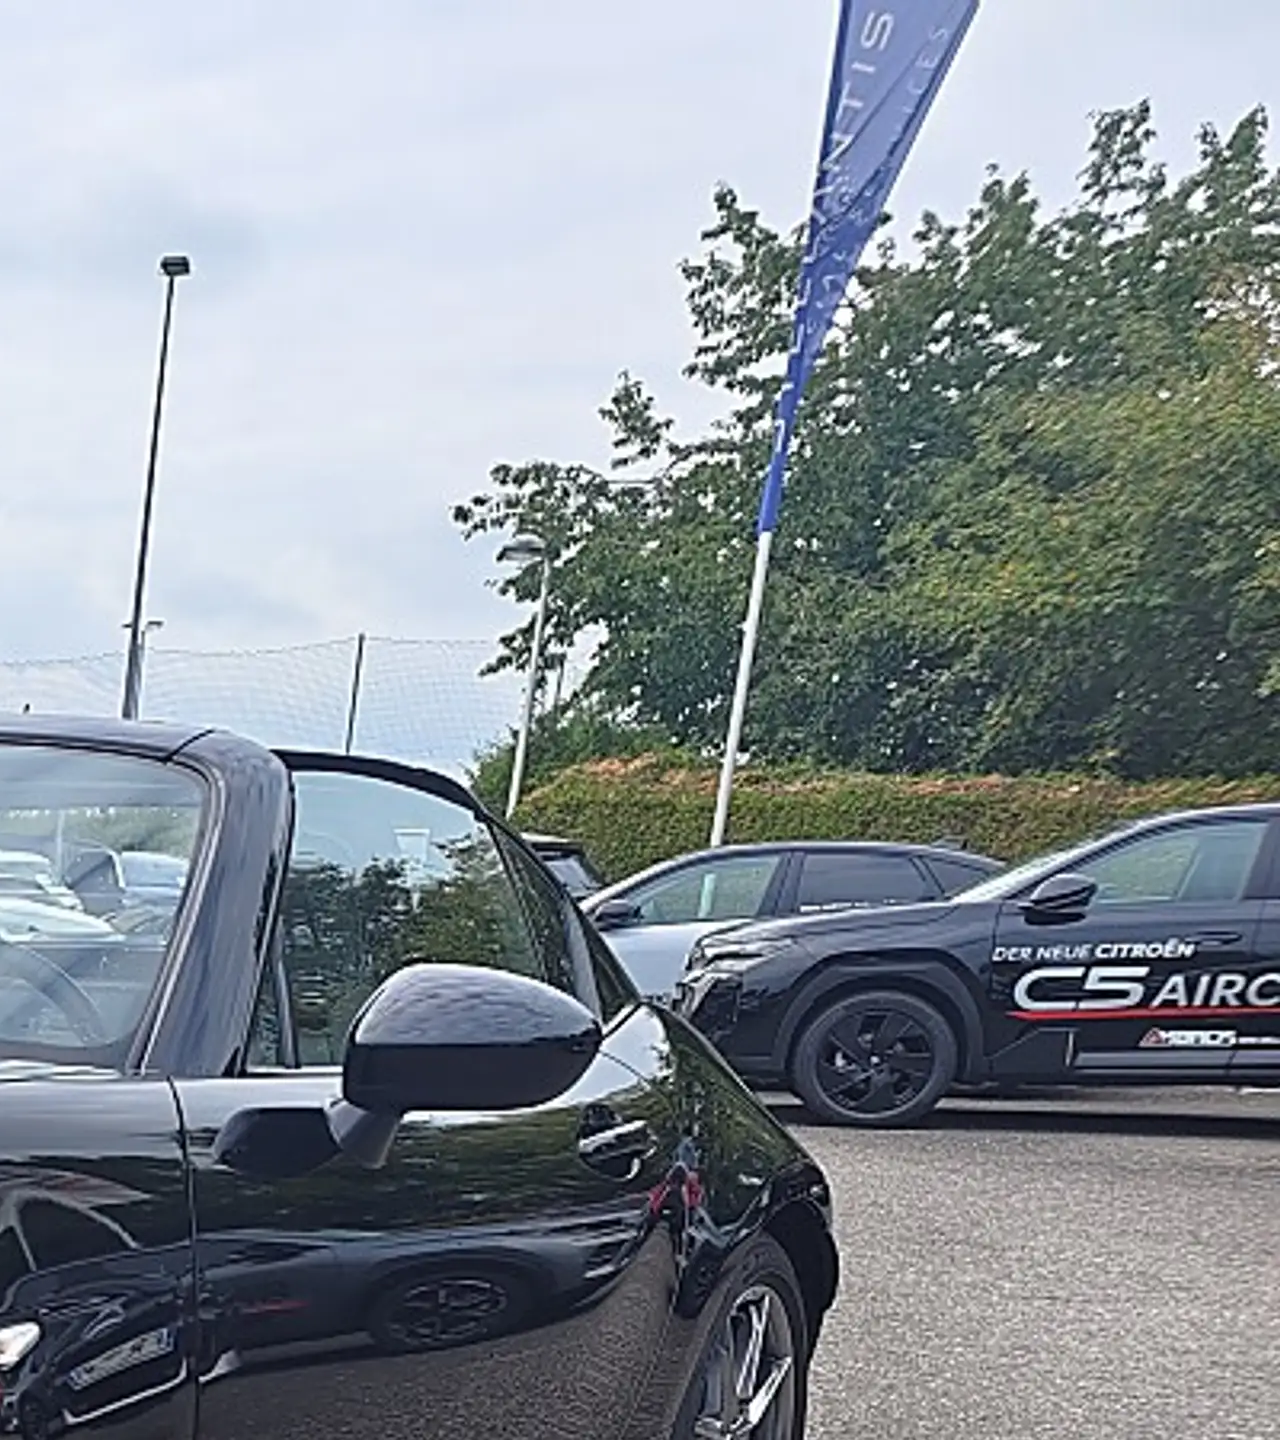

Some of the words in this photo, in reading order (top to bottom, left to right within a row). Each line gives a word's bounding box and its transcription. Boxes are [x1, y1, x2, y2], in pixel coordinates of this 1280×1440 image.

[992, 946, 1032, 962] DER
[1036, 943, 1092, 961] NEUE
[1095, 937, 1195, 959] CITROËN
[1014, 966, 1150, 1011] C5
